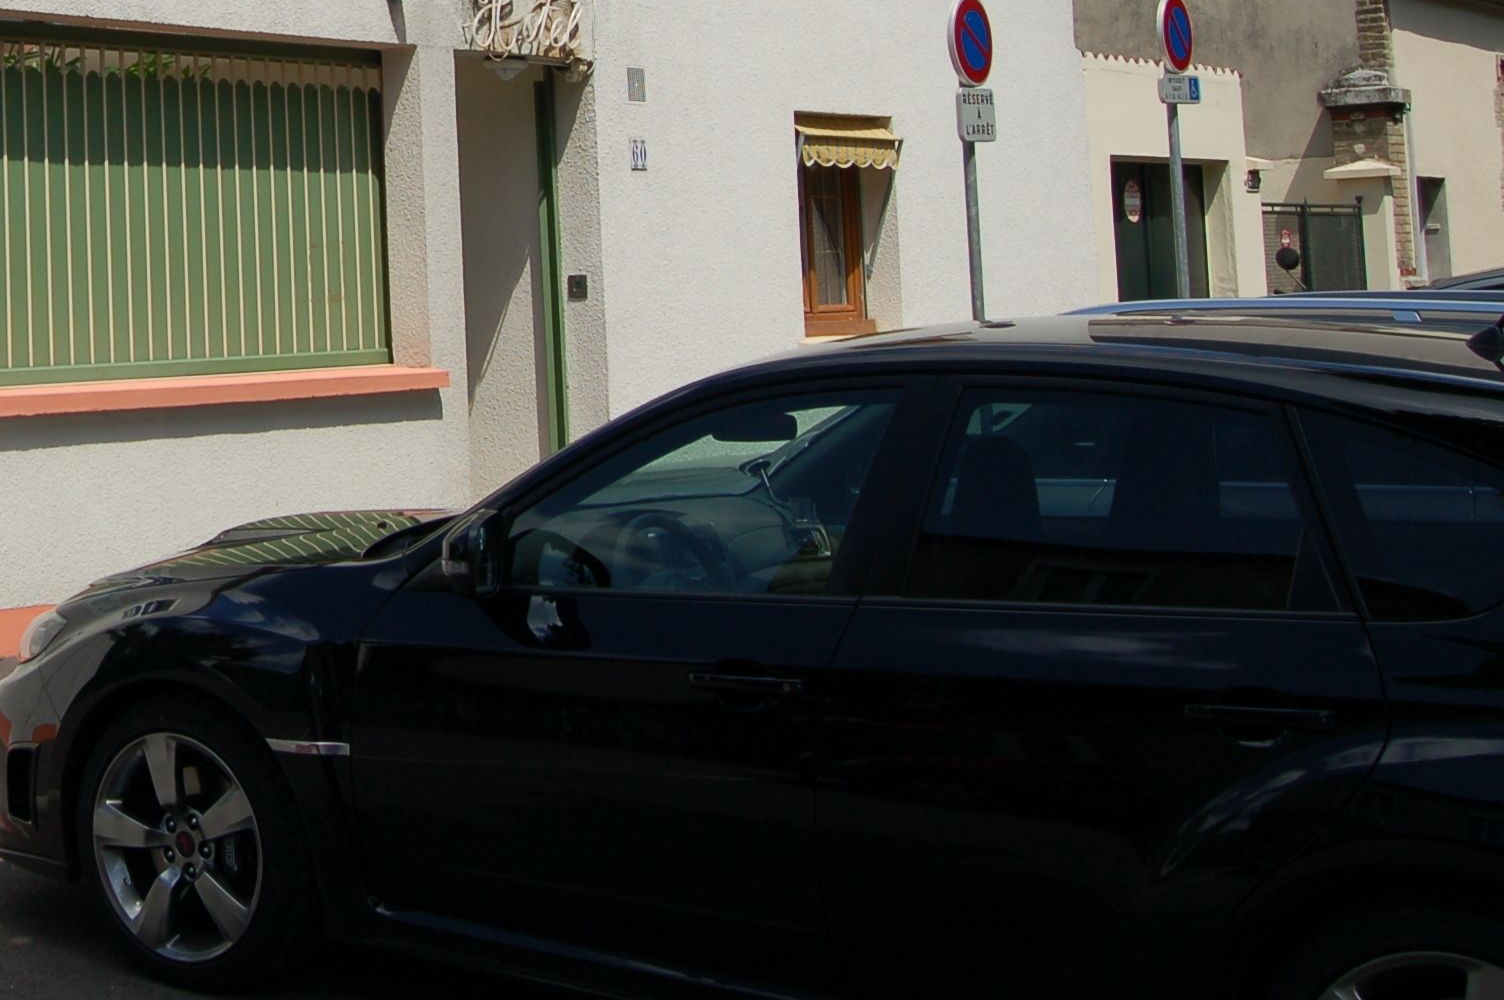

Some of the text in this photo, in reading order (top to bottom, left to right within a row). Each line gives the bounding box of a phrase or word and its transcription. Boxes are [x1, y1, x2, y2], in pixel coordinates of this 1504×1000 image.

[962, 90, 993, 105] RÉSERVÉ
[966, 121, 994, 136] L'ARRÊT
[632, 143, 647, 164] 60
